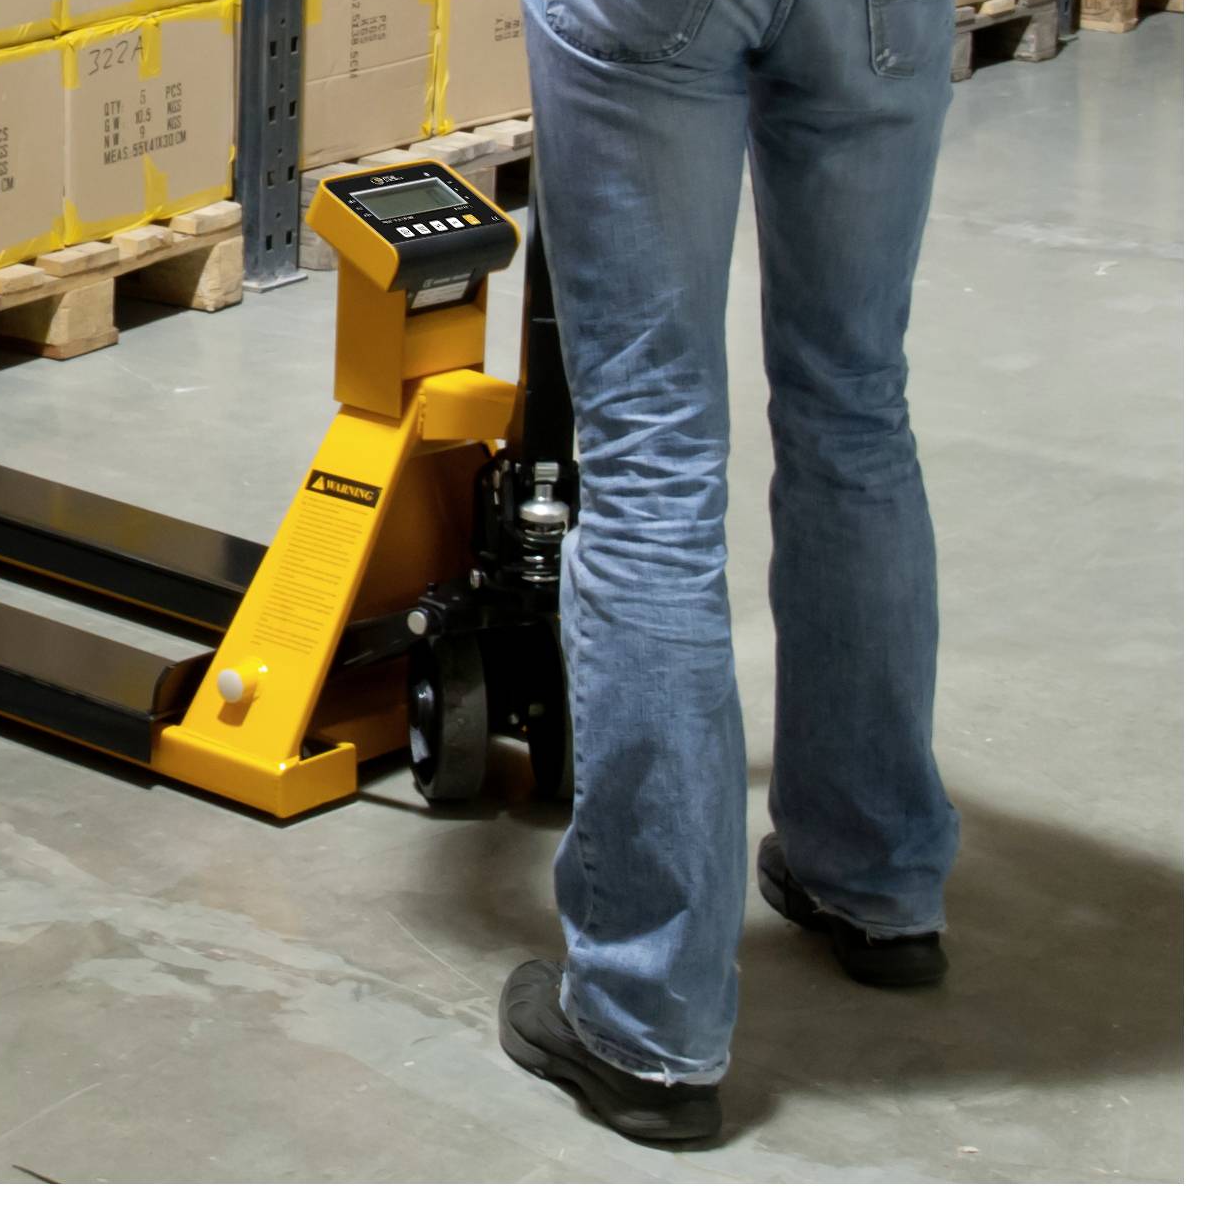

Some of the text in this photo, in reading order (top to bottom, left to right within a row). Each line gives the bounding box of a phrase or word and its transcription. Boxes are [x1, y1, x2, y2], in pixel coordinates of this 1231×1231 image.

[88, 35, 144, 75] 322A
[165, 82, 182, 99] PCS
[326, 479, 374, 502] WARNING
